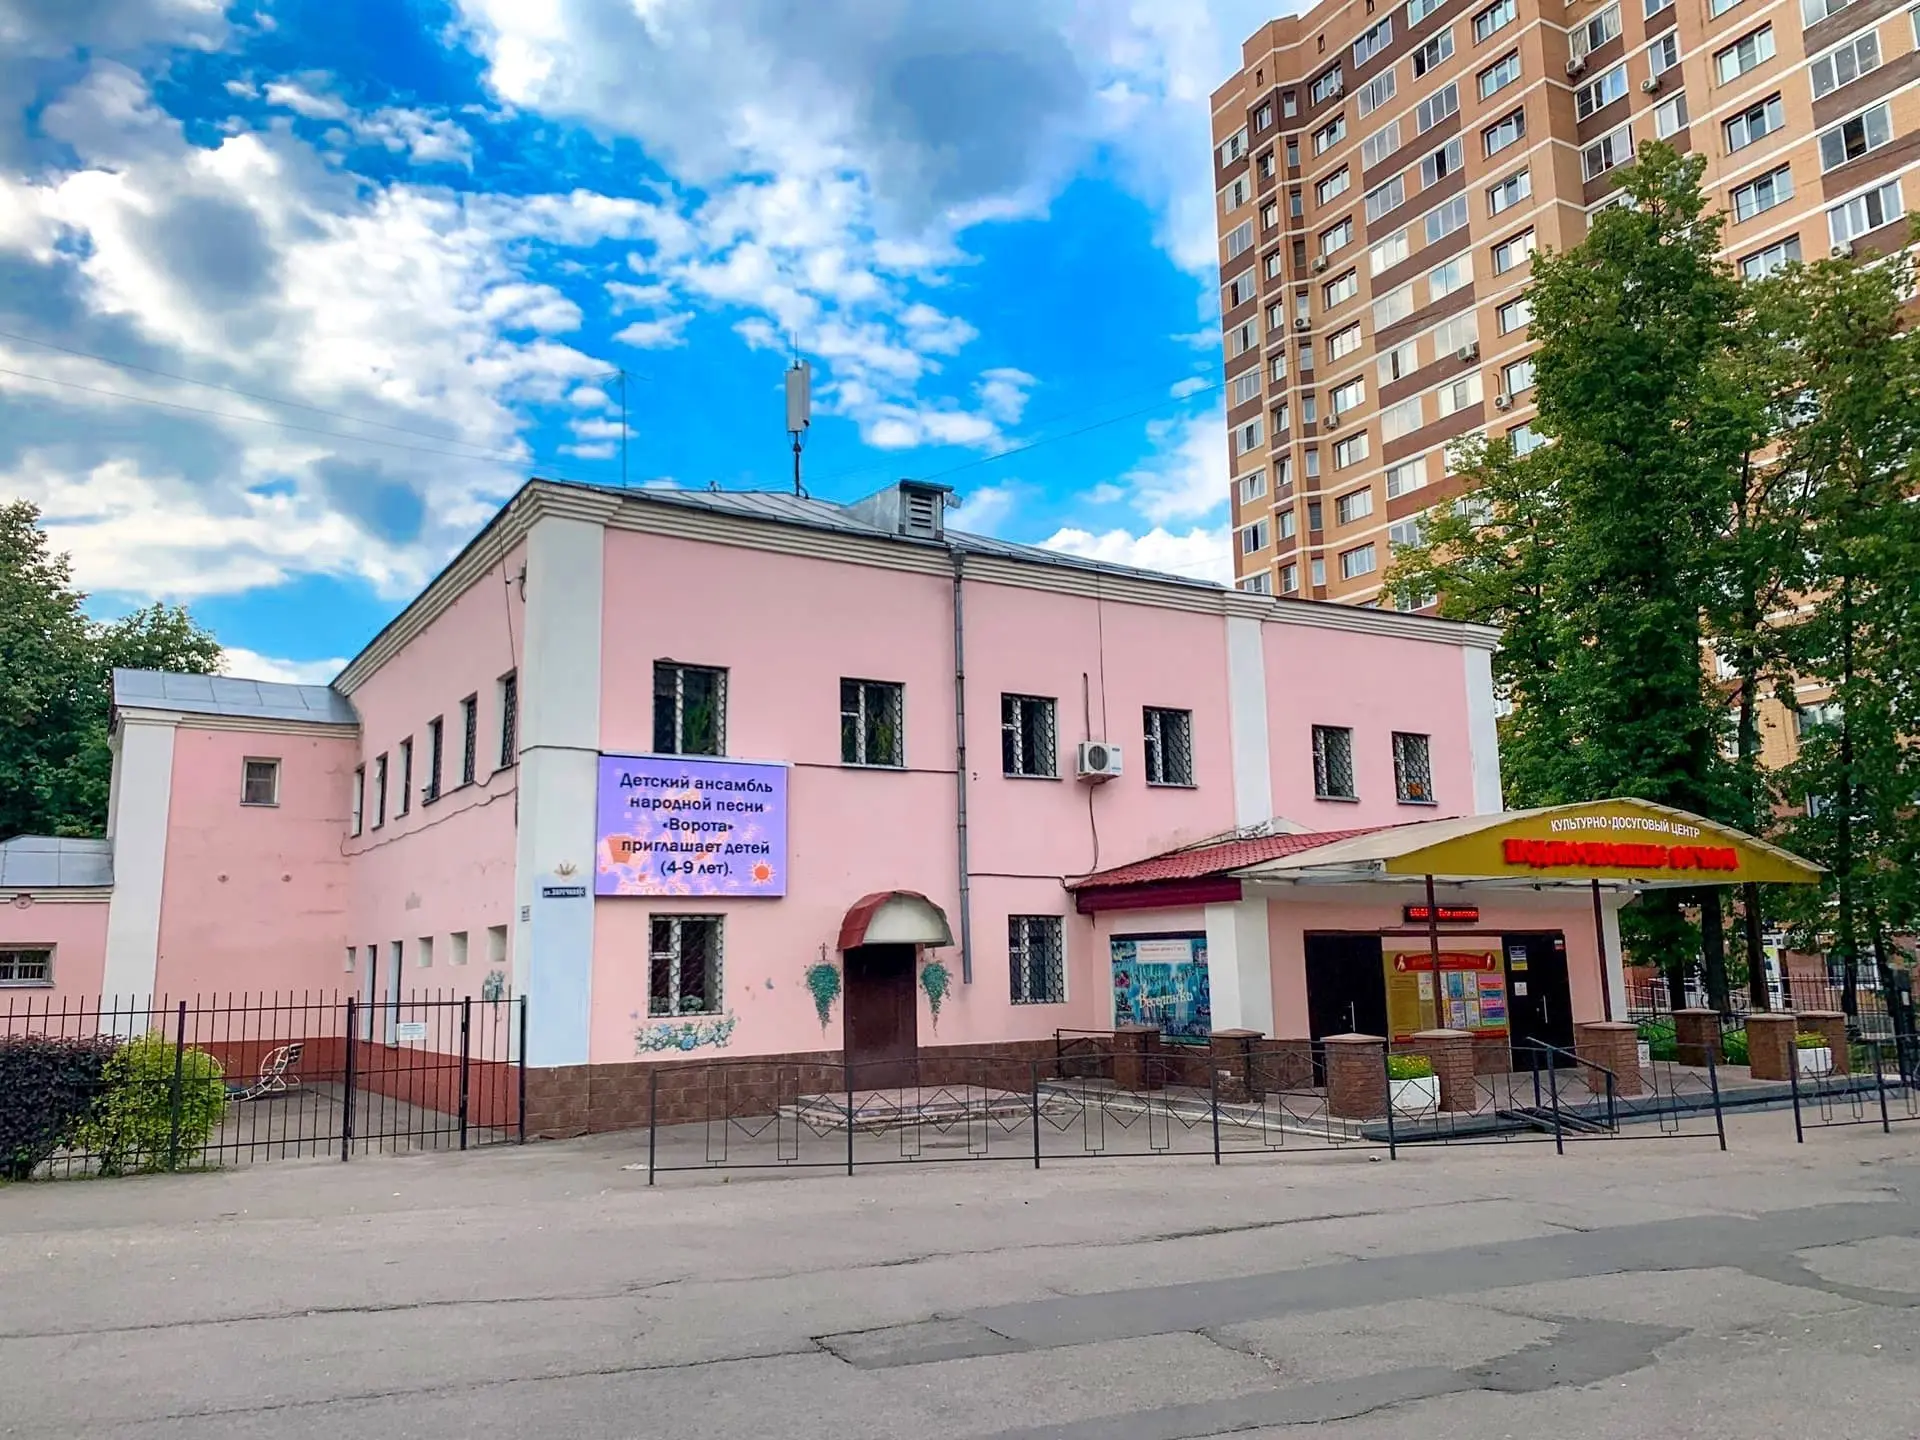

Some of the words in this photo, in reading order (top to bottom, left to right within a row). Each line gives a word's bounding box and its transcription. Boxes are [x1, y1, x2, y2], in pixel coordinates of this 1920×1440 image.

[619, 772, 690, 789] Детский
[694, 778, 773, 793] ансамбль
[630, 797, 712, 811] народной
[716, 800, 764, 813] песни
[662, 817, 734, 833] «Ворота»
[1671, 822, 1701, 838] ЦЕНТР
[621, 840, 722, 854] приглашает
[724, 841, 770, 854] детей
[660, 861, 694, 876] (4-9
[697, 861, 733, 877] лет).
